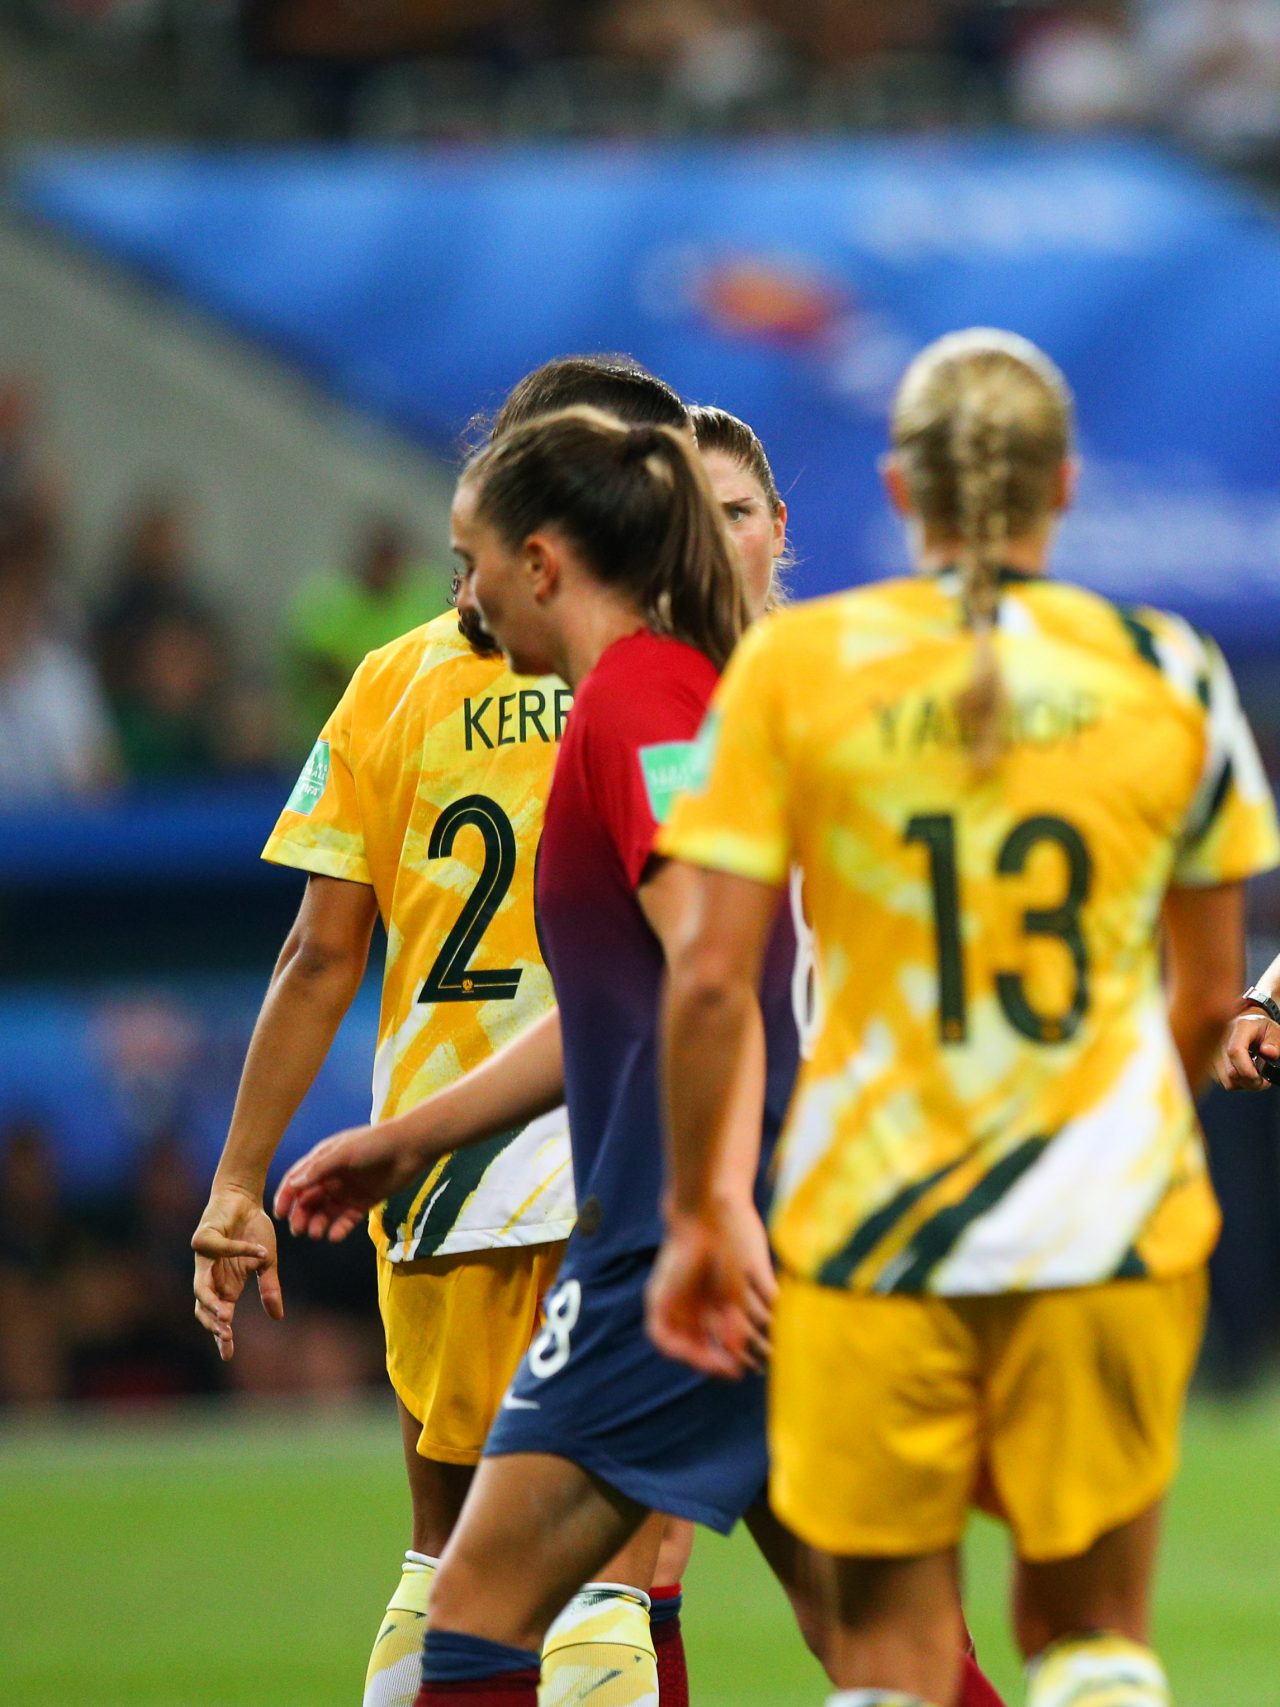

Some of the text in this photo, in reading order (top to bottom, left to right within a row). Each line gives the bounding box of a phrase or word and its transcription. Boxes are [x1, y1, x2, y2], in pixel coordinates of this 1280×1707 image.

[417, 794, 524, 1004] 2
[903, 812, 1094, 1047] 13
[528, 1278, 582, 1379] 8
